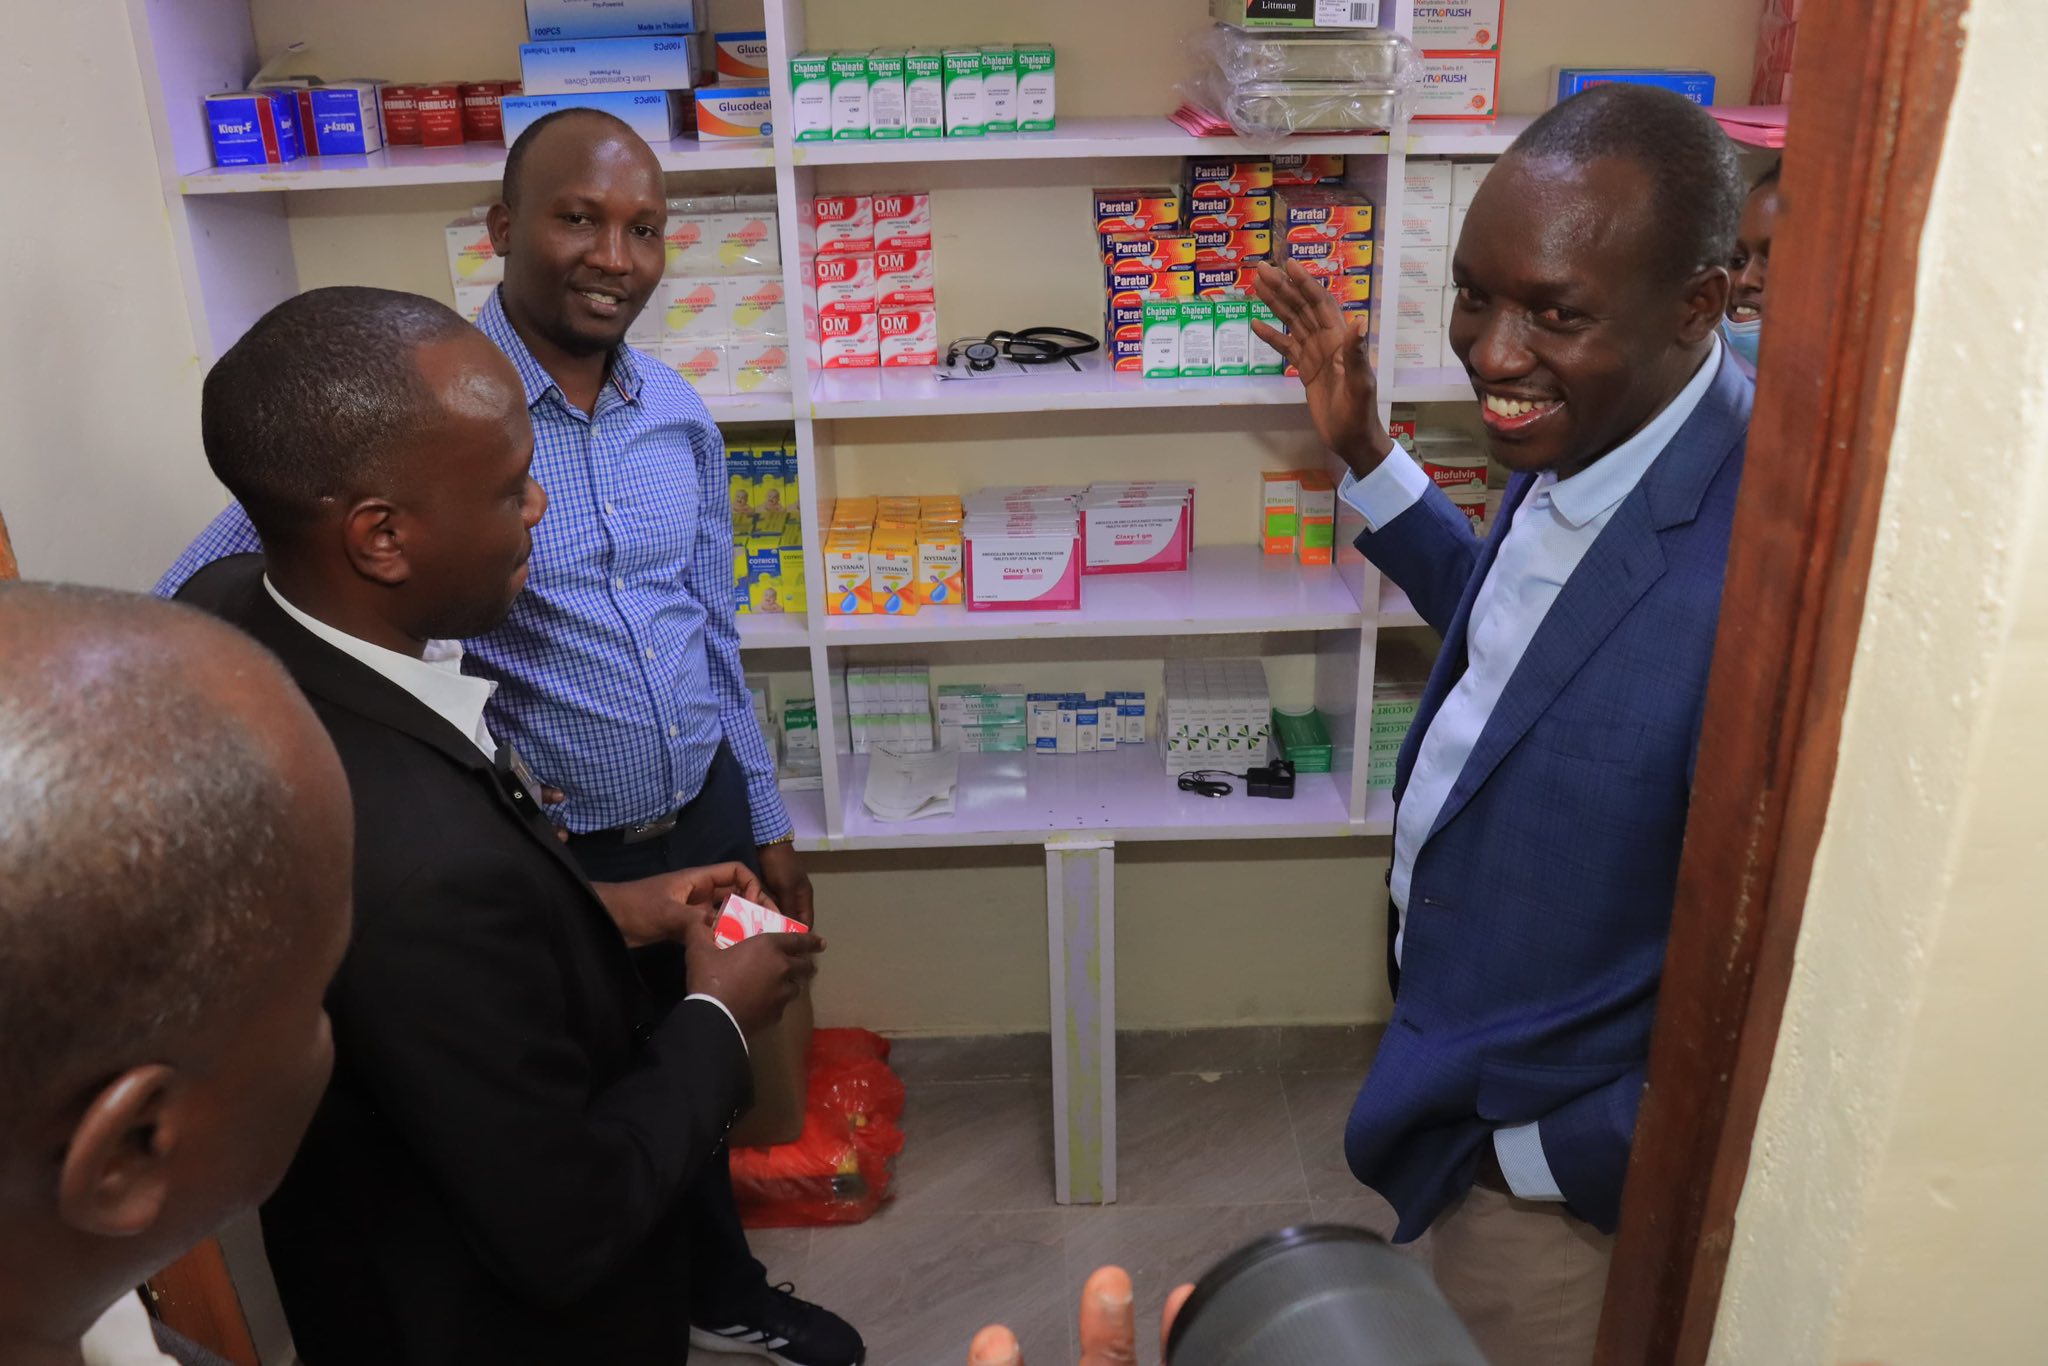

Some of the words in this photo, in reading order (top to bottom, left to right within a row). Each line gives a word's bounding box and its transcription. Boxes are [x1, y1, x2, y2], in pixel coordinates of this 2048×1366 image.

[1261, 1, 1296, 10] Littmann
[1413, 8, 1472, 17] ECTRORUSH
[534, 27, 561, 36] 100PCS
[637, 23, 655, 31] Made
[663, 21, 689, 30] Thailand
[523, 47, 550, 55] Thailand
[653, 42, 681, 51] 100PCS
[737, 44, 766, 54] Gluco
[907, 59, 939, 70] Chaleate
[946, 58, 979, 69] Chaleate
[982, 55, 1014, 65] Chaleate
[1019, 54, 1051, 64] Chaleate
[793, 62, 826, 74] Chaleate
[831, 61, 864, 72] Chaleate
[868, 61, 901, 71] Chaleate
[956, 67, 970, 75] Syrup
[564, 78, 588, 86] Gloves
[589, 76, 631, 85] Examination
[632, 74, 651, 83] Latex
[1418, 74, 1467, 83] TRORUSH
[384, 99, 418, 110] FERROLIC-L
[634, 96, 661, 105] 100PCS
[718, 100, 772, 112] Glucodeal
[218, 121, 253, 134] Kloxy-F
[323, 121, 356, 134] Kloxy-F
[1195, 165, 1229, 177] Paratal
[817, 201, 844, 216] OM
[874, 198, 902, 214] OM
[1099, 201, 1134, 212] Paratal
[1192, 199, 1227, 210] Paratal
[1290, 208, 1326, 220] Paratal
[1115, 241, 1151, 253] Paratal
[1291, 243, 1327, 255] Paratal
[877, 253, 905, 269] OM
[817, 263, 845, 278] OM
[1114, 274, 1149, 286] Paratal
[1199, 271, 1234, 283] Paratal
[1117, 308, 1142, 320] Parat
[1146, 306, 1177, 317] Chaleate
[1181, 305, 1212, 316] Chaleate
[1216, 304, 1247, 315] Chaleate
[1251, 304, 1272, 315] Chale
[1190, 313, 1204, 321] Syrup
[822, 317, 849, 332] OM
[881, 316, 908, 331] OM
[1117, 340, 1142, 352] Parat
[1434, 469, 1476, 480] Biofulvin
[1115, 533, 1140, 541] Claxy-1
[1003, 567, 1030, 575] Claxy-1
[1375, 742, 1400, 752] CORT
